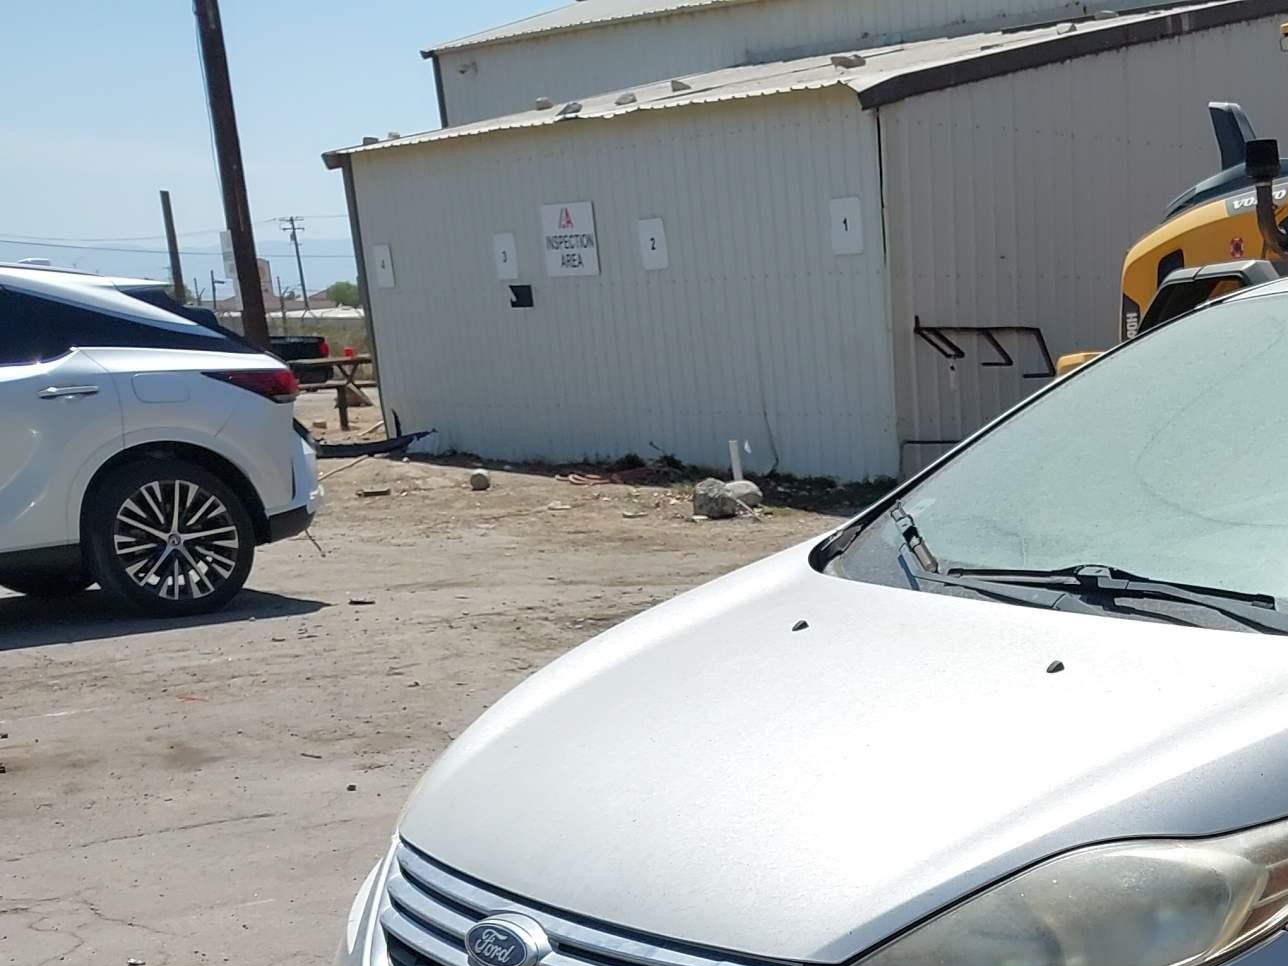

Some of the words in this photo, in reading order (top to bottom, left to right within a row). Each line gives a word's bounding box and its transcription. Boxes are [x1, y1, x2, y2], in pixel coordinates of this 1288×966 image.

[1232, 189, 1287, 209] VOO
[545, 233, 594, 251] INSPECTION
[649, 237, 657, 251] 2
[561, 253, 584, 269] AREA
[474, 928, 516, 963] Ford
